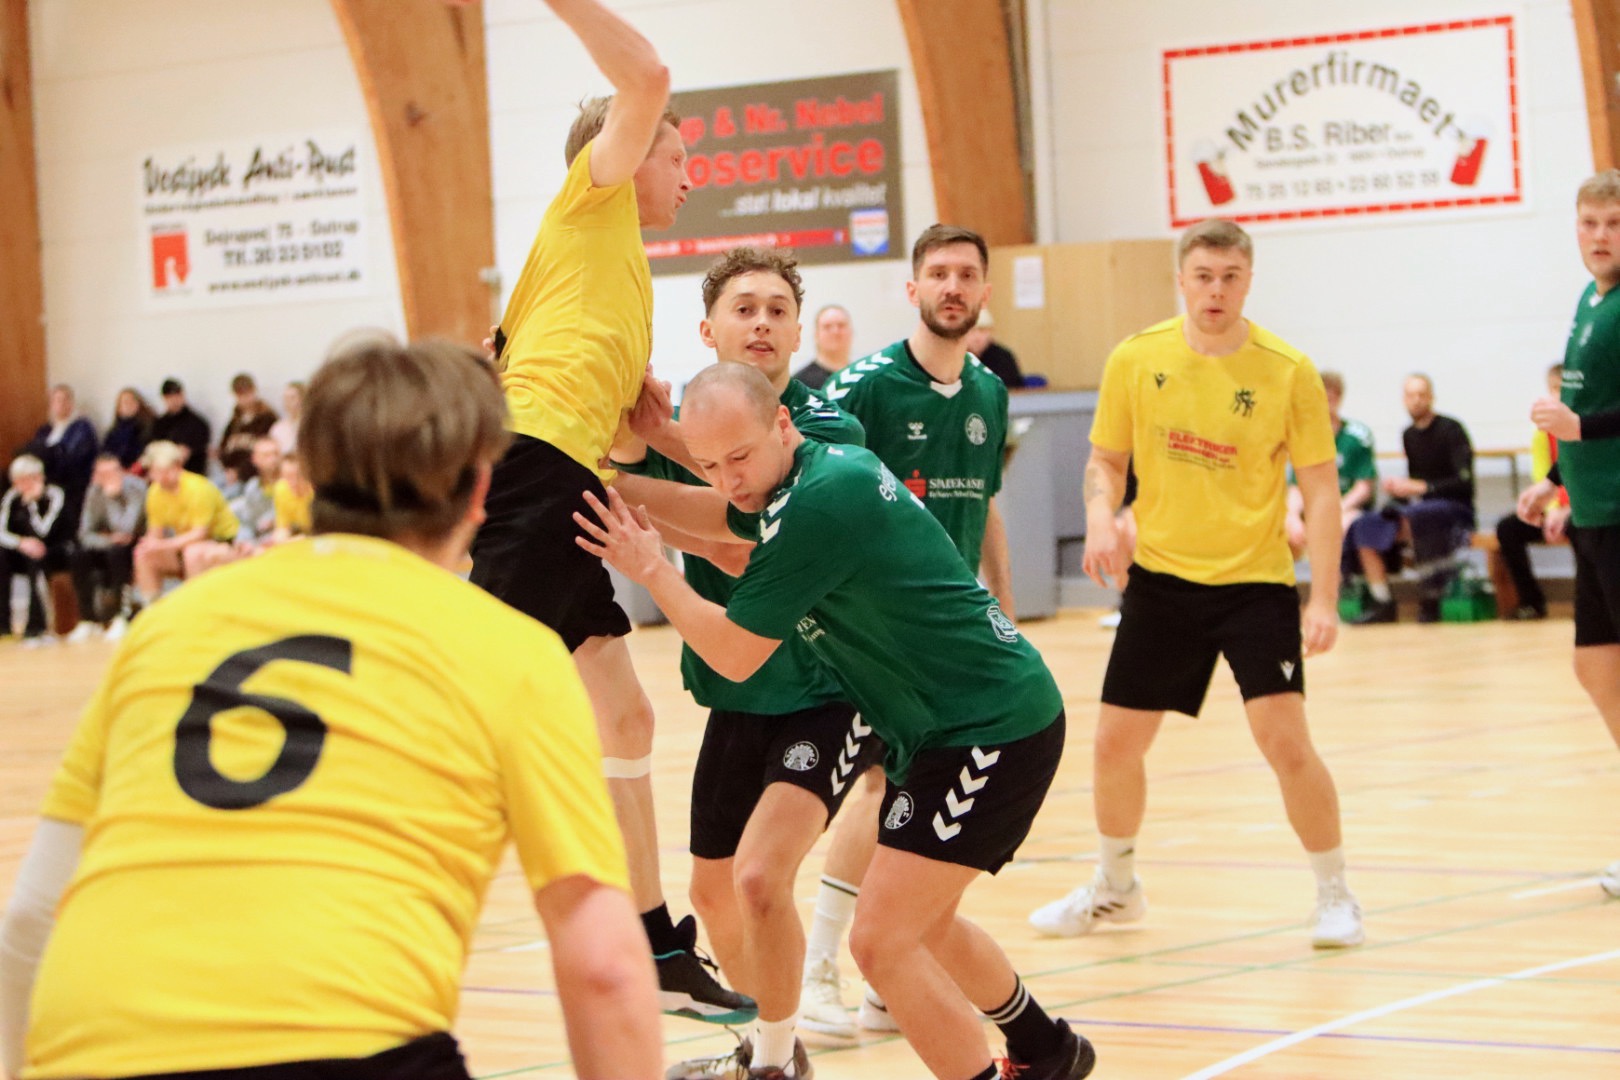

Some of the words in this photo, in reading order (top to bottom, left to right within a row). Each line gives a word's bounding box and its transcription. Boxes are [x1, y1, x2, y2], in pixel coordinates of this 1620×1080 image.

[795, 92, 884, 129] Nebel
[1226, 50, 1454, 151] Murerfirmaet
[686, 133, 885, 188] oservice
[1266, 123, 1316, 152] B.S.
[1324, 121, 1392, 146] Riber
[243, 138, 356, 189] Anti-Rust
[772, 187, 820, 212] lokal
[174, 635, 352, 810] 6
